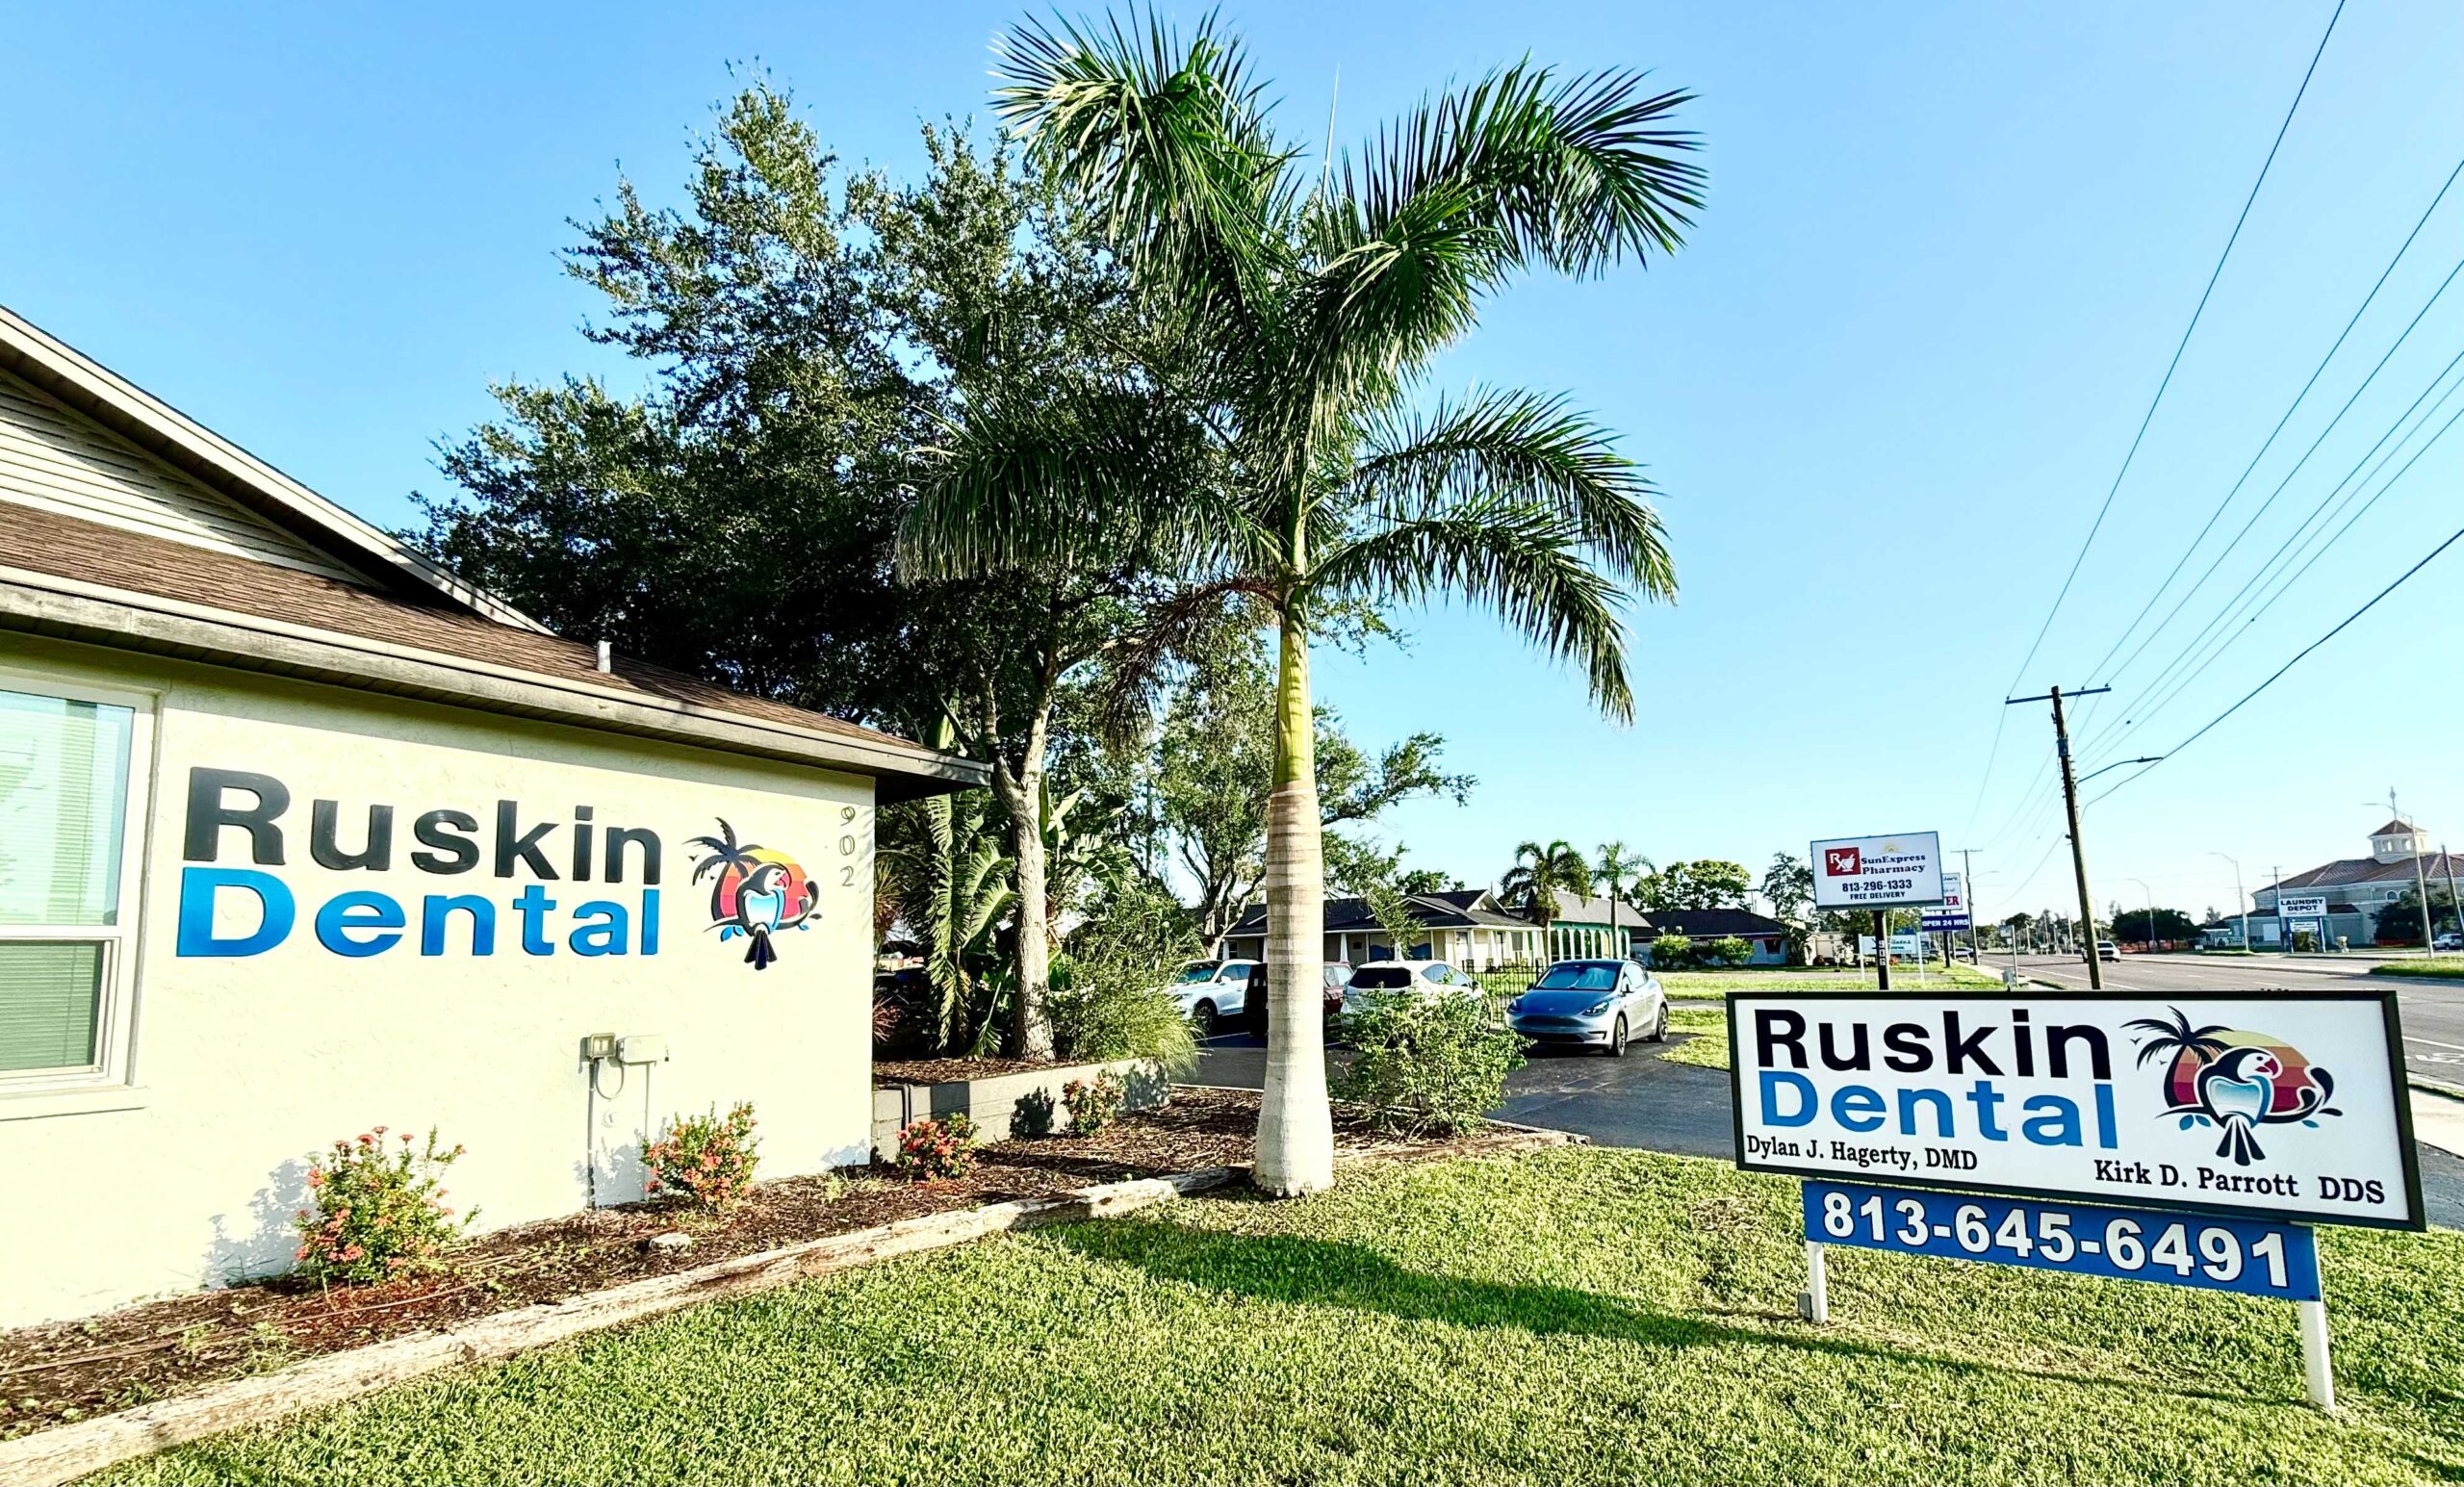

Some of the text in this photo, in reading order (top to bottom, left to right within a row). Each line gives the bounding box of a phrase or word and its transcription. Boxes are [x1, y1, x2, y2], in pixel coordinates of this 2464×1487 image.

[183, 766, 662, 885] Ruskin
[1842, 879, 1912, 891] 813-296-1333
[1861, 855, 1926, 864] SunExpress
[1861, 864, 1926, 875] Pharmacy
[175, 866, 661, 958] Dental
[1754, 1008, 2112, 1081] Ruskin
[1758, 1070, 2119, 1149] Dental
[1746, 1135, 1979, 1172] Dylan J. Hagerty, DMD
[2094, 1159, 2385, 1205] Kirk D. Parrott DDS
[1823, 1192, 2289, 1289] 813-645-6491
